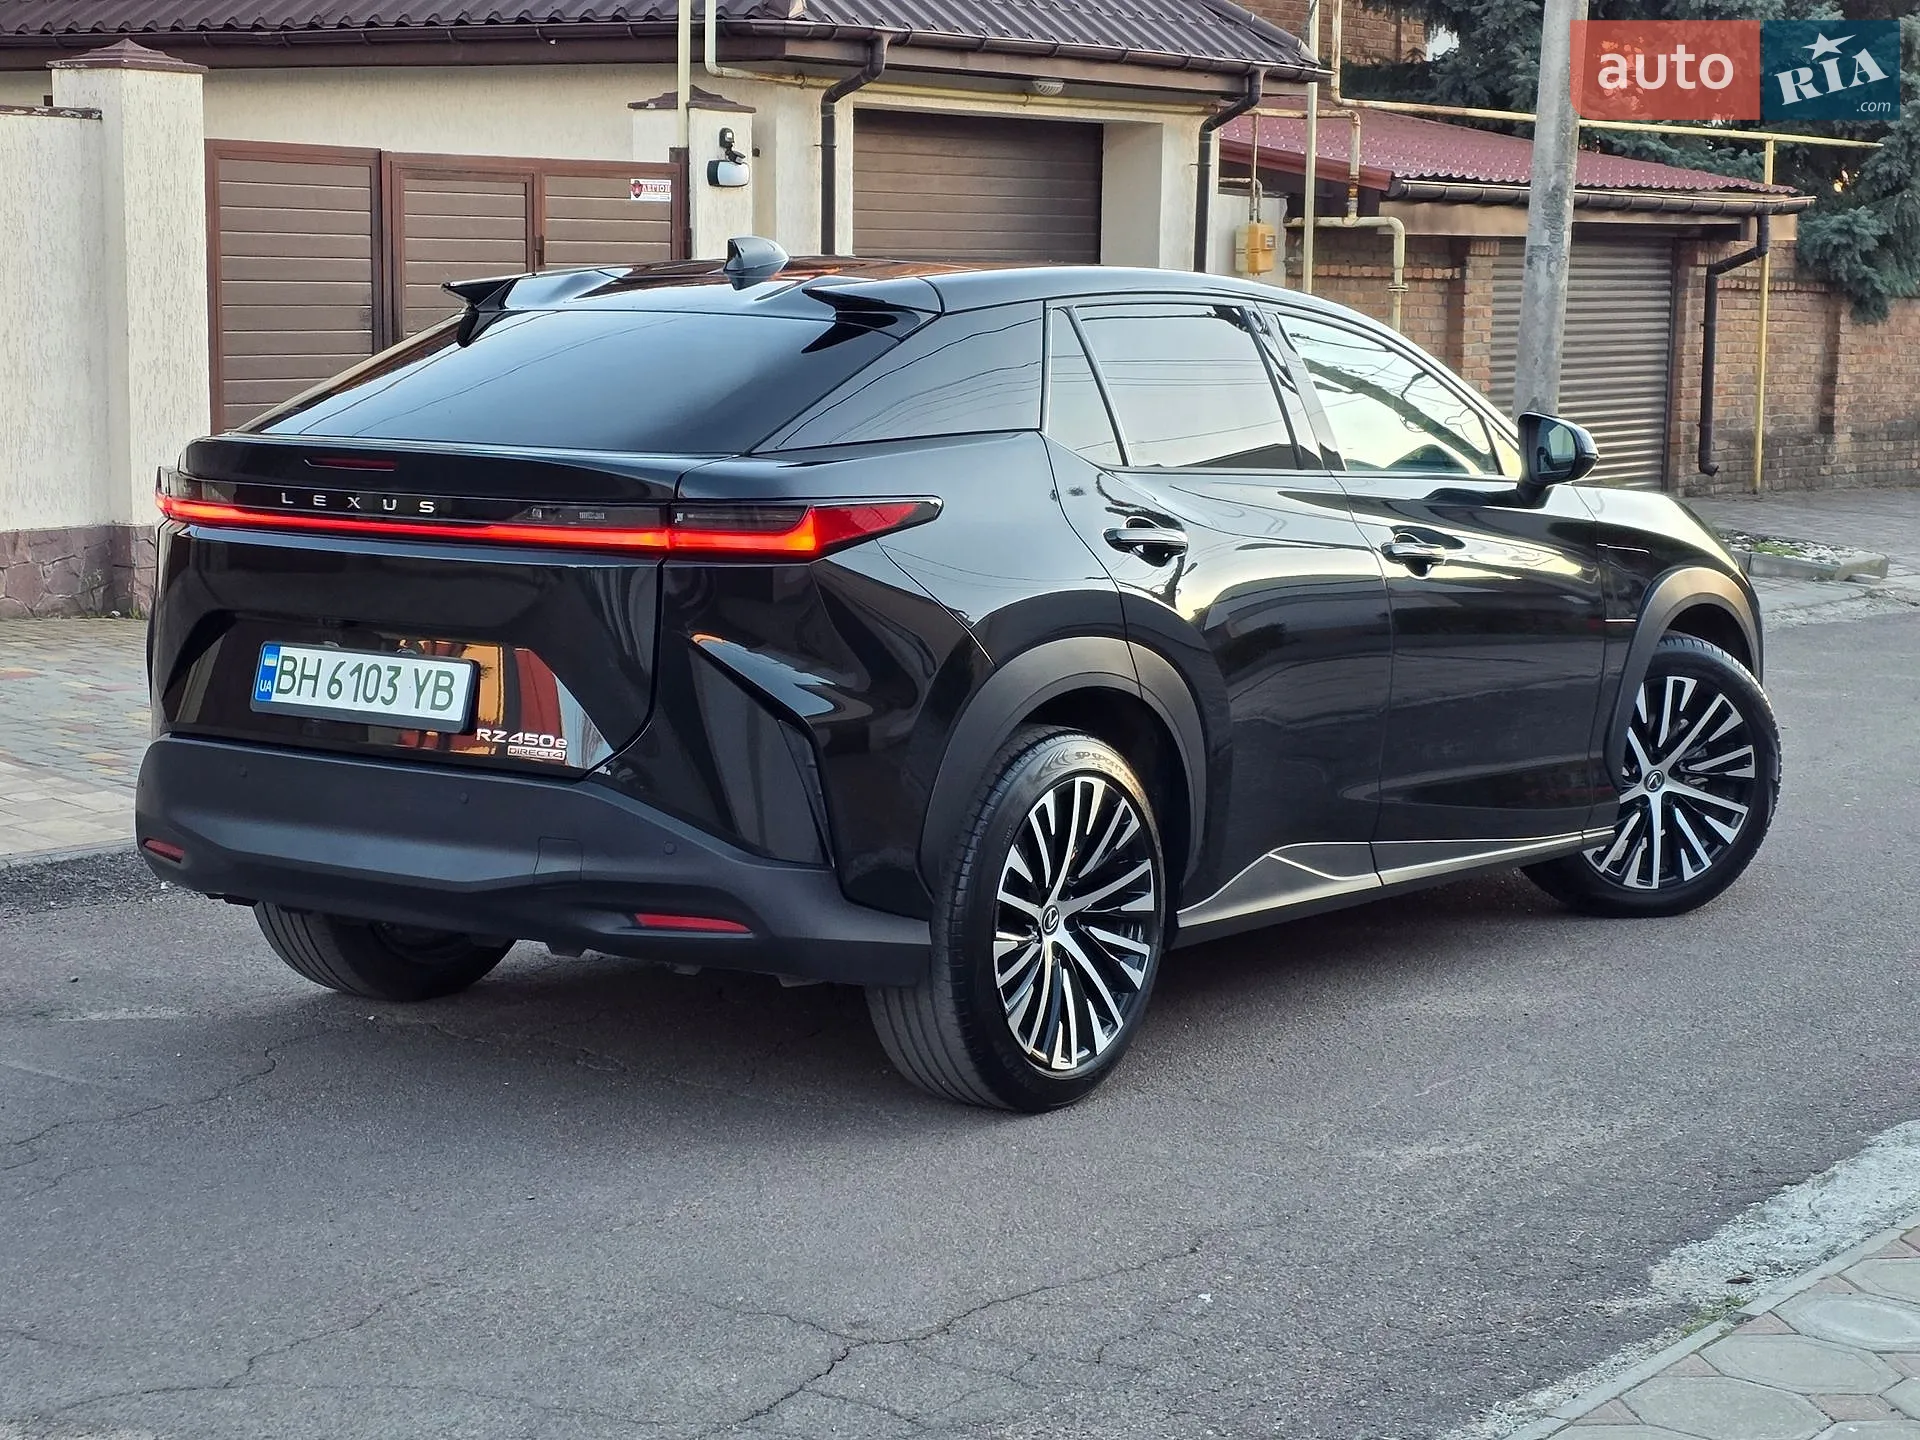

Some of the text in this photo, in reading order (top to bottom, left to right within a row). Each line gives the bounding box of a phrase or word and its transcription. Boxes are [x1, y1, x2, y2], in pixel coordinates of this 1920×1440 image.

[281, 492, 435, 514] LEXUS
[260, 679, 272, 693] UA
[275, 655, 455, 712] BH 6103 YB
